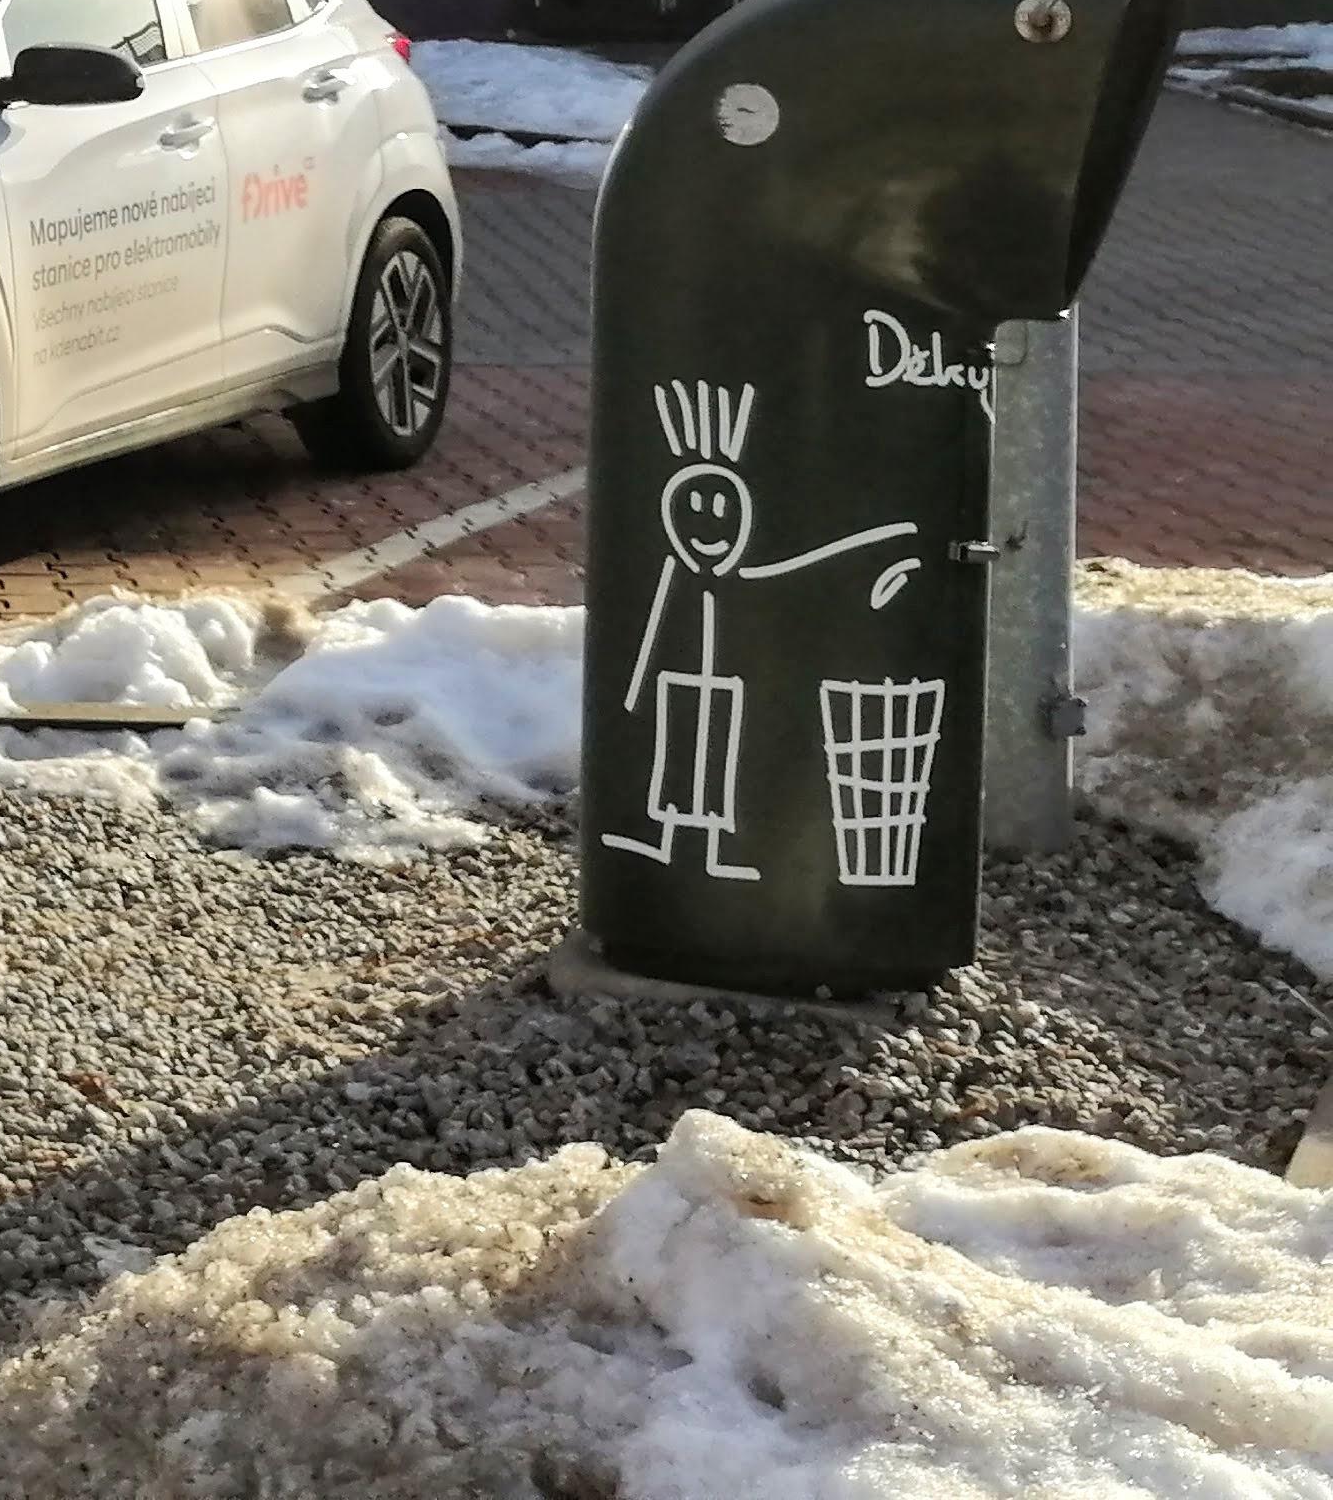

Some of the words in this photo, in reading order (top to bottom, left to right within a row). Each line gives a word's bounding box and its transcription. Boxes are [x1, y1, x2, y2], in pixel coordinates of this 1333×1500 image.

[30, 208, 119, 247] Mapujeme
[121, 190, 159, 225] nové
[33, 255, 92, 291] stanice
[94, 250, 122, 281] pro
[123, 219, 222, 266] elektromobily
